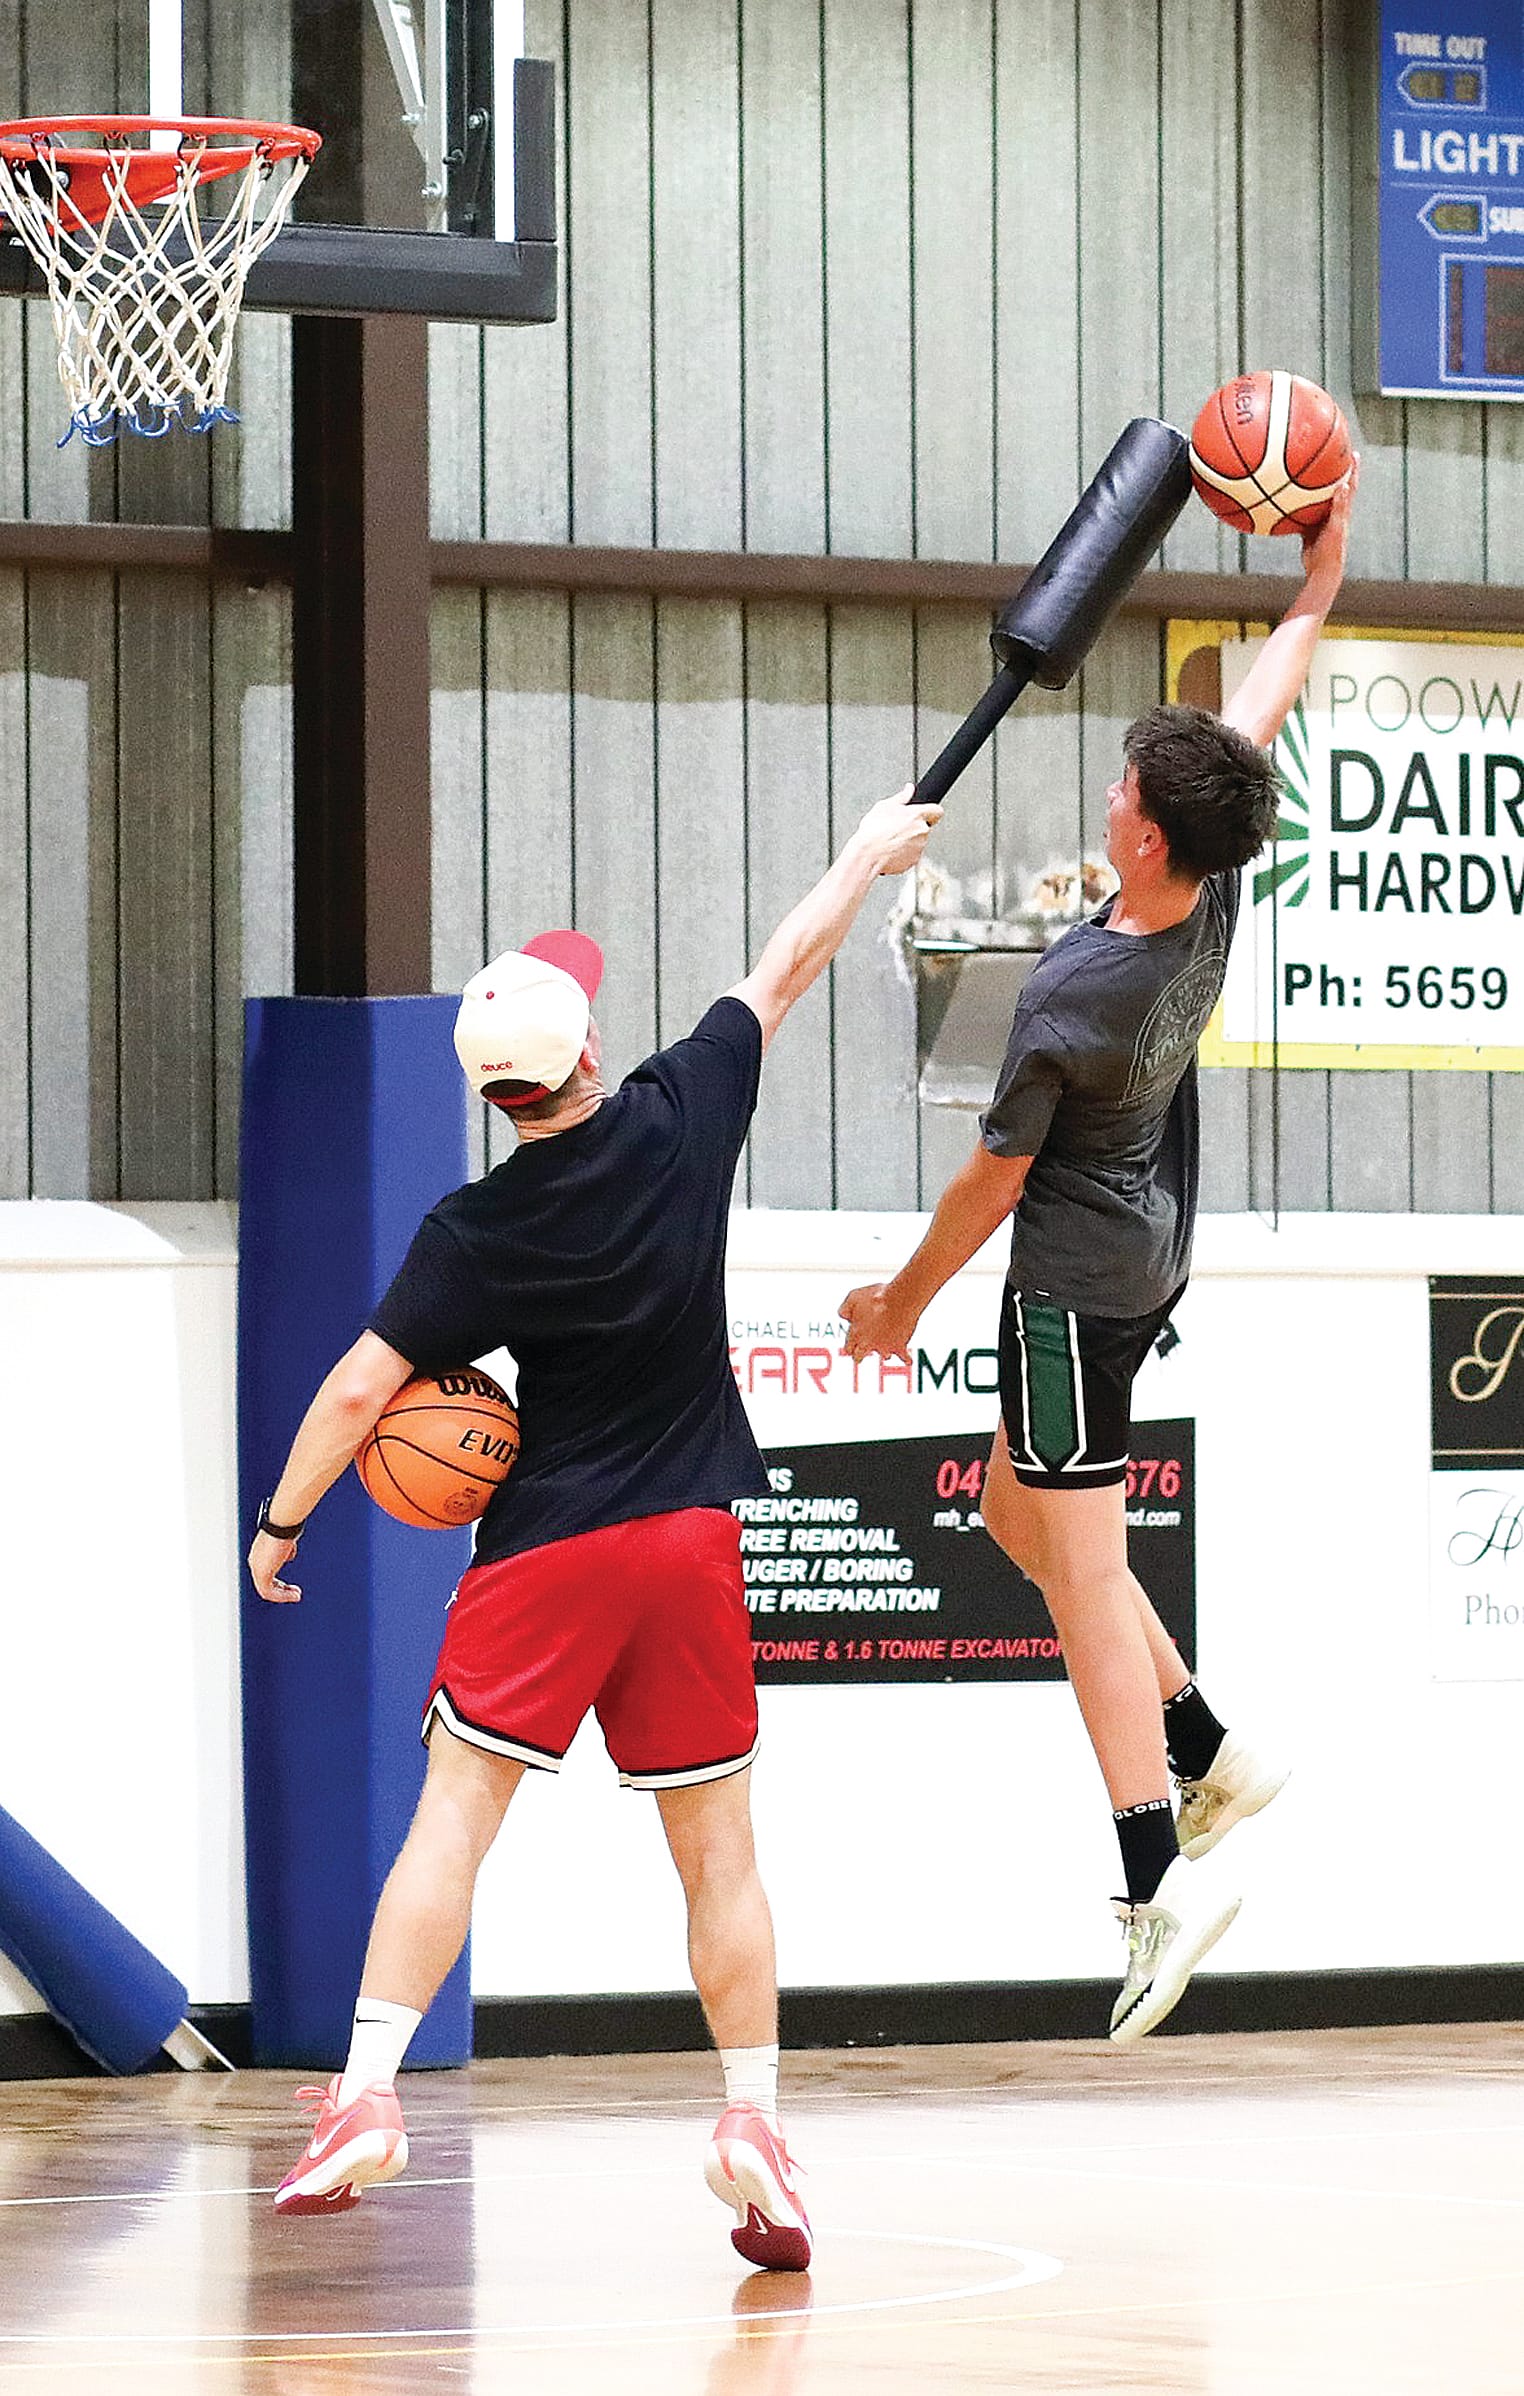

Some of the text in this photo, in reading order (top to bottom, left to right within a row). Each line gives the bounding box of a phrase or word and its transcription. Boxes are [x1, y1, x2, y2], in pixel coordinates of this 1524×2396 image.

[1394, 32, 1487, 61] TIME OUT
[1393, 128, 1524, 176] LIGHT
[1329, 673, 1523, 735] POOW
[1329, 748, 1524, 838] DAIR
[1283, 962, 1509, 1011] Ph: 5659
[480, 1060, 514, 1073] deuce
[730, 1497, 859, 1523] TRENCHING
[789, 1527, 900, 1552] REMOVAL
[808, 1558, 823, 1582] /
[822, 1557, 915, 1583] BORING
[779, 1587, 941, 1614] PREPARATION
[1463, 1592, 1524, 1626] Pho
[751, 1641, 819, 1662] TONNE
[823, 1640, 840, 1661] &
[845, 1640, 874, 1661] 1.6
[877, 1639, 946, 1661] TONNE
